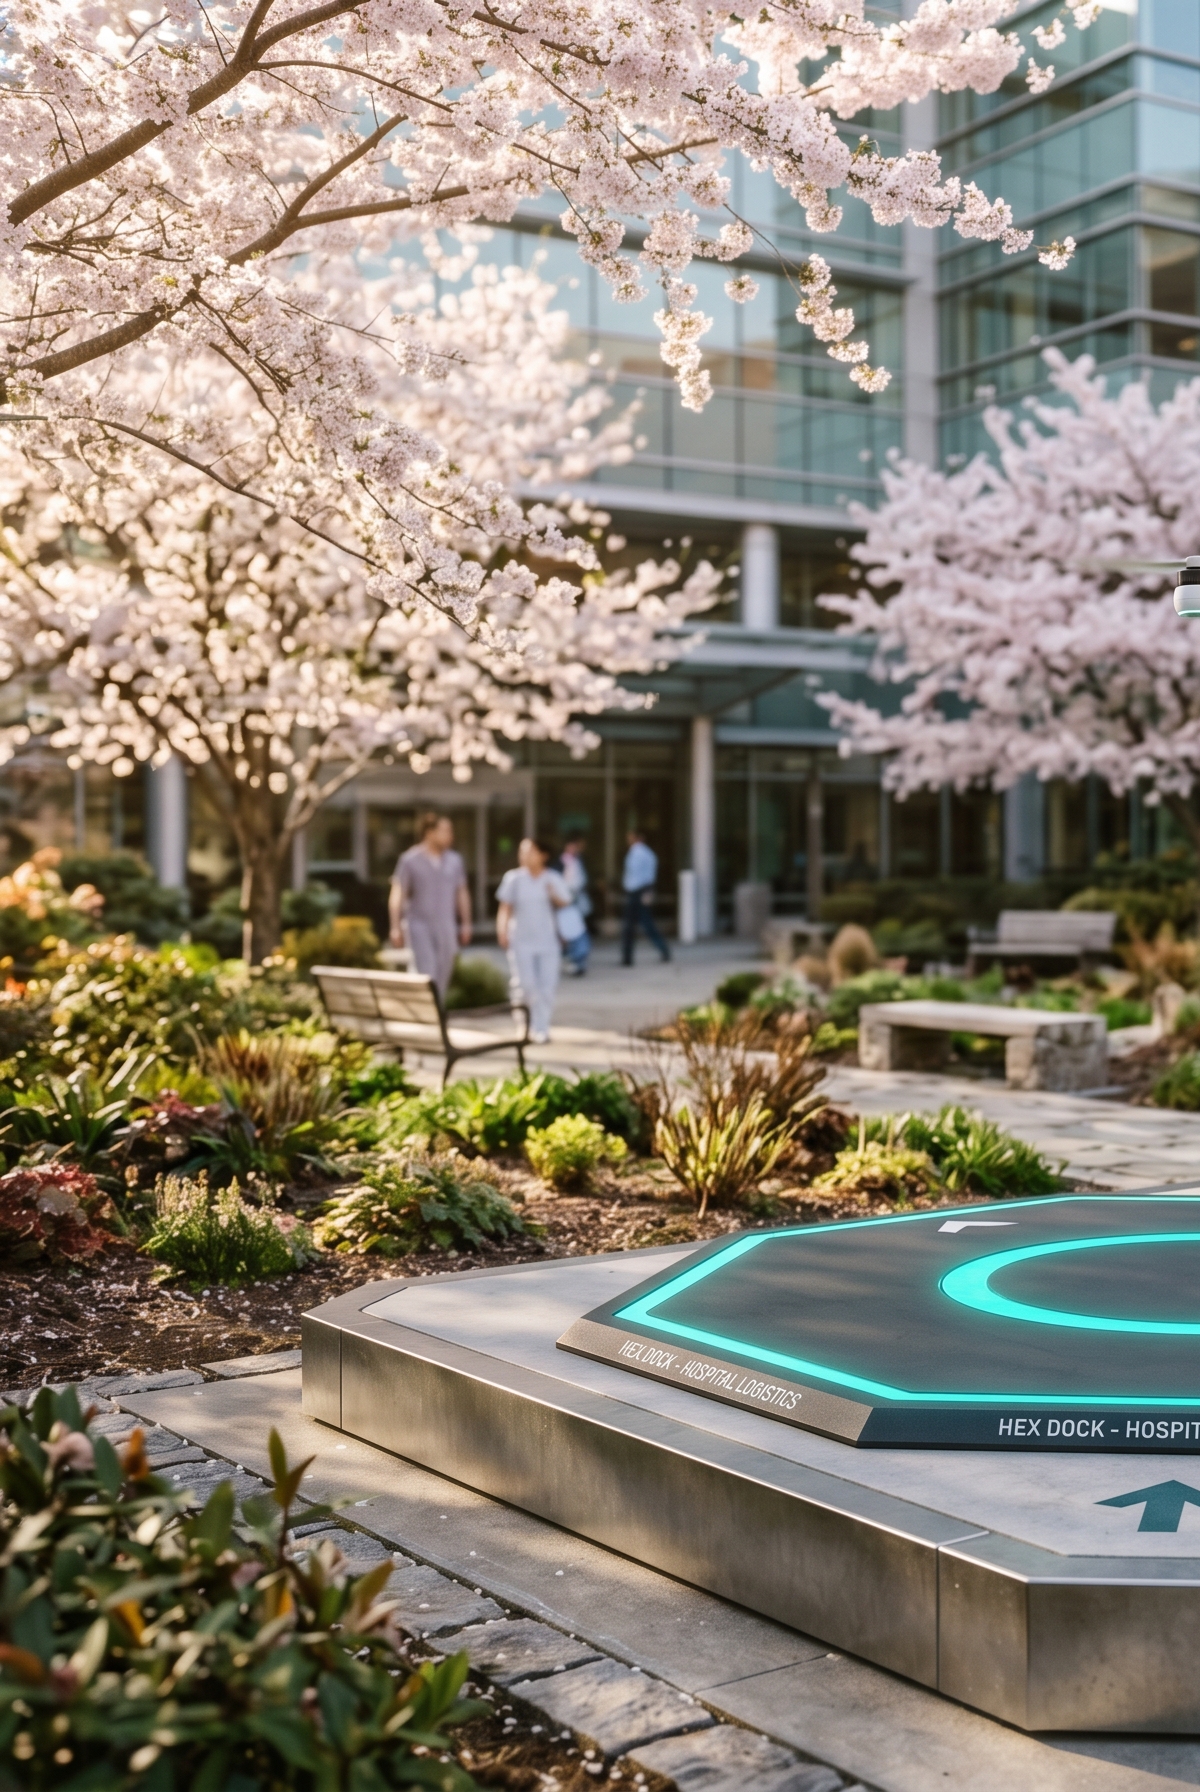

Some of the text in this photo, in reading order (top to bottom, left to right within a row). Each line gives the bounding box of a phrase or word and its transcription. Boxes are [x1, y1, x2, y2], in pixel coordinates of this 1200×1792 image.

[618, 1340, 648, 1360] HEX
[642, 1347, 679, 1371] DOCK
[680, 1360, 738, 1390] HOSPITAL
[735, 1376, 802, 1410] LOGISTICS
[998, 1418, 1042, 1437] HEX
[1046, 1419, 1106, 1439] DOCK
